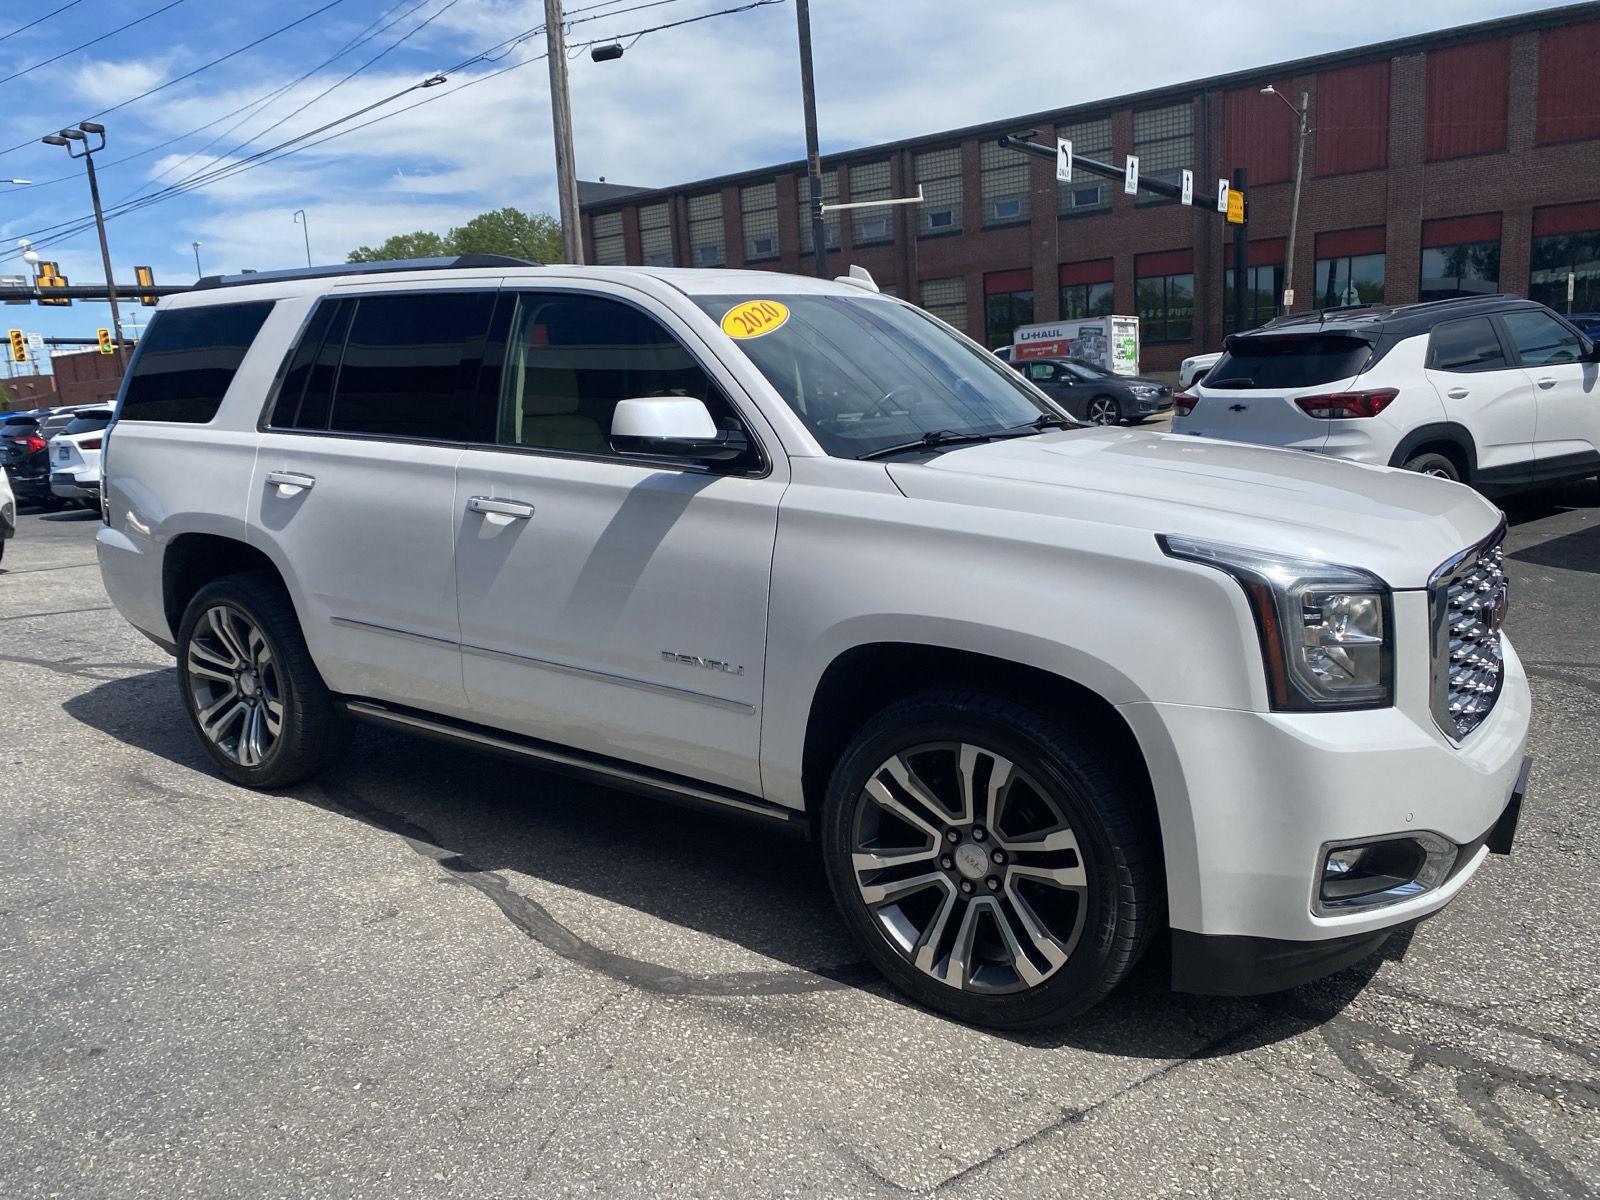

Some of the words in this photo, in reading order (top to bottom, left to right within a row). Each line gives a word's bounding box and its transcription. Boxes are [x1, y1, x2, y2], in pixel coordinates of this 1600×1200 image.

[1059, 168, 1069, 178] ONLY
[733, 303, 779, 334] 2020
[1021, 329, 1063, 340] U-HAUL
[661, 650, 744, 677] DENALI
